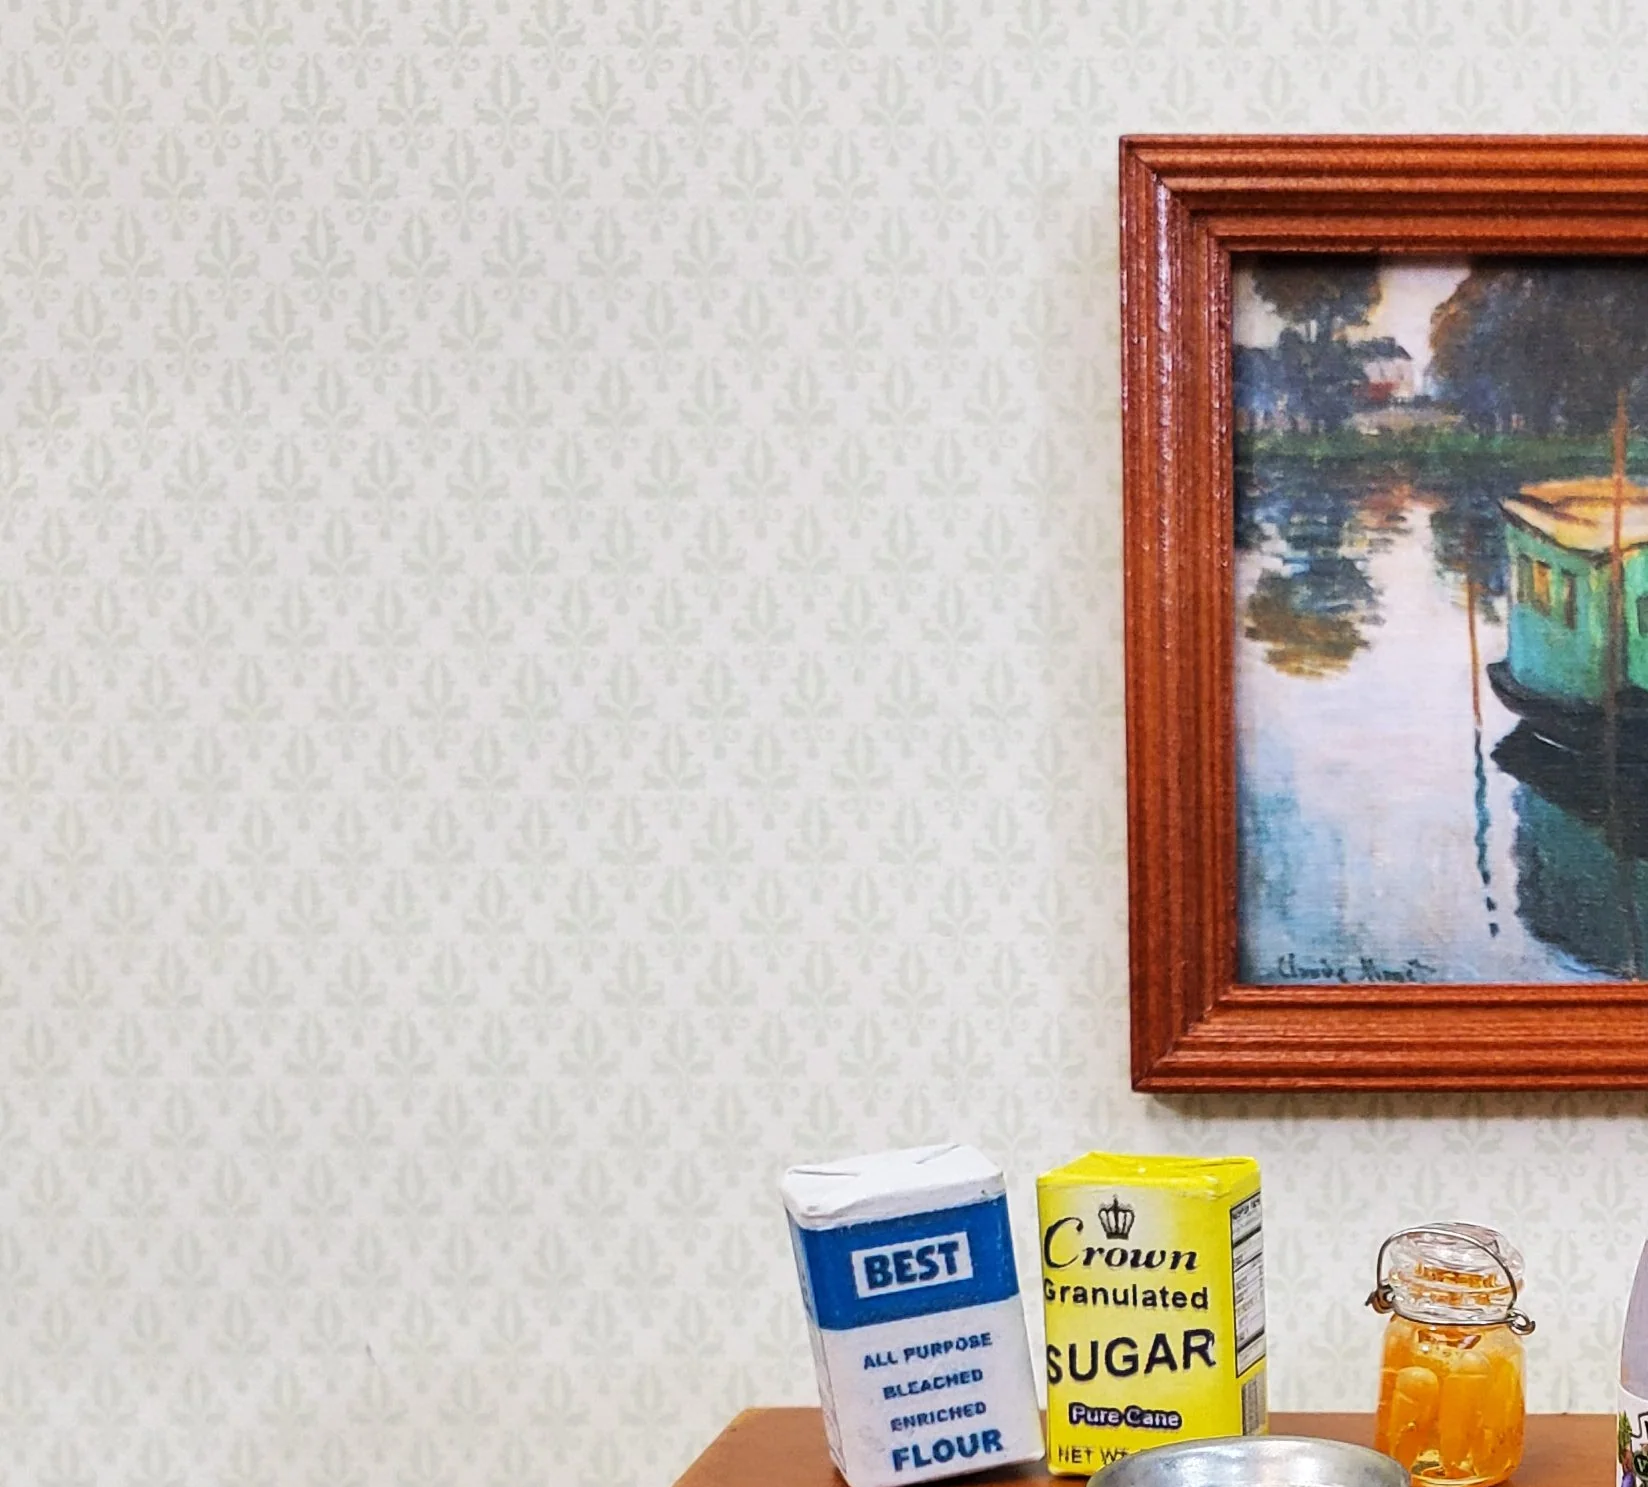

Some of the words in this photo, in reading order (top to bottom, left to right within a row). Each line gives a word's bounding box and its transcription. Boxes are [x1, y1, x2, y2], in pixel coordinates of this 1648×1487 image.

[1043, 1216, 1198, 1271] Crown
[863, 1240, 960, 1291] BEST
[1044, 1278, 1209, 1310] Granulated
[863, 1353, 898, 1370] ALL
[903, 1332, 993, 1364] PURPOSE
[1047, 1328, 1217, 1385] SUGAR
[882, 1368, 984, 1401] BLEACHED
[889, 1401, 987, 1432] ENRICHED
[1071, 1404, 1120, 1424] Pure
[1126, 1407, 1180, 1427] Cane
[892, 1428, 1003, 1473] FLOUR
[1058, 1445, 1094, 1464] NET
